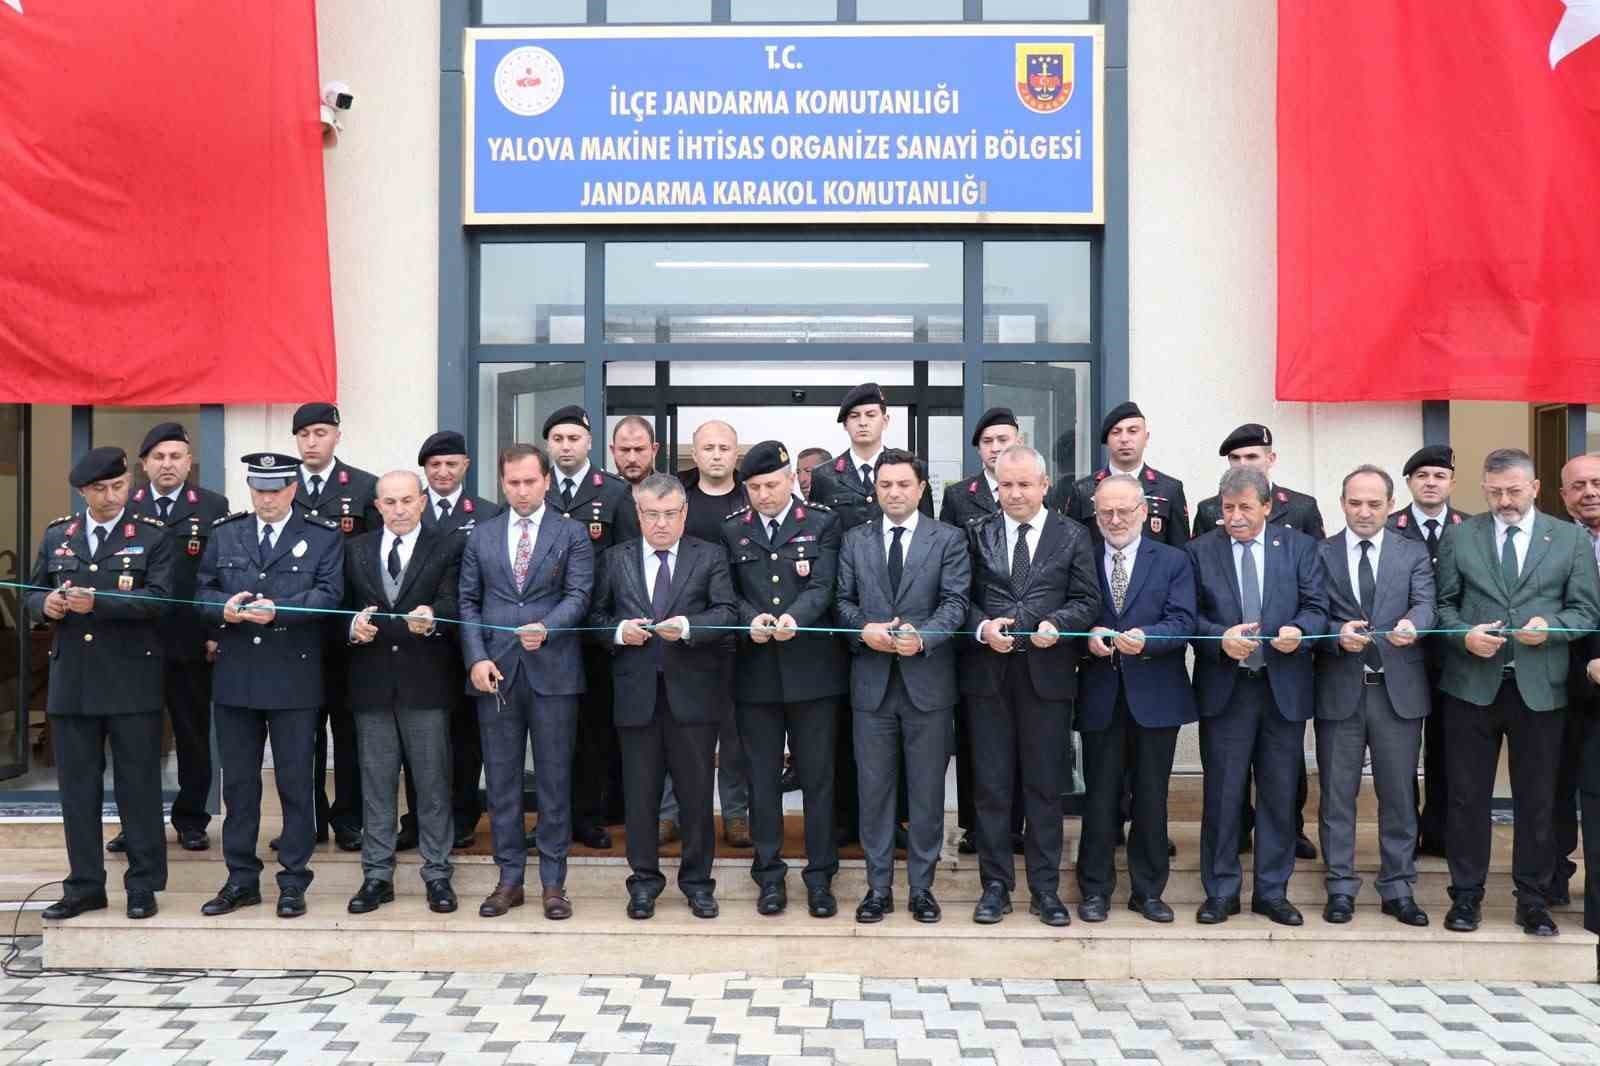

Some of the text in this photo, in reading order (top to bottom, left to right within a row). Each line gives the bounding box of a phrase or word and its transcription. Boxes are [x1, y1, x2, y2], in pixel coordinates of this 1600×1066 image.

[765, 45, 803, 70] T.C.
[610, 83, 960, 122] İLÇE JANDARMA KOMUTANLIĞI
[488, 128, 1082, 161] YALOVA MAKİNE İHTİSAS ORGANİZE SANAYİ BÖLGESİ
[580, 174, 988, 206] JANDARMA KARAKOL KOMUTANLIĞI
